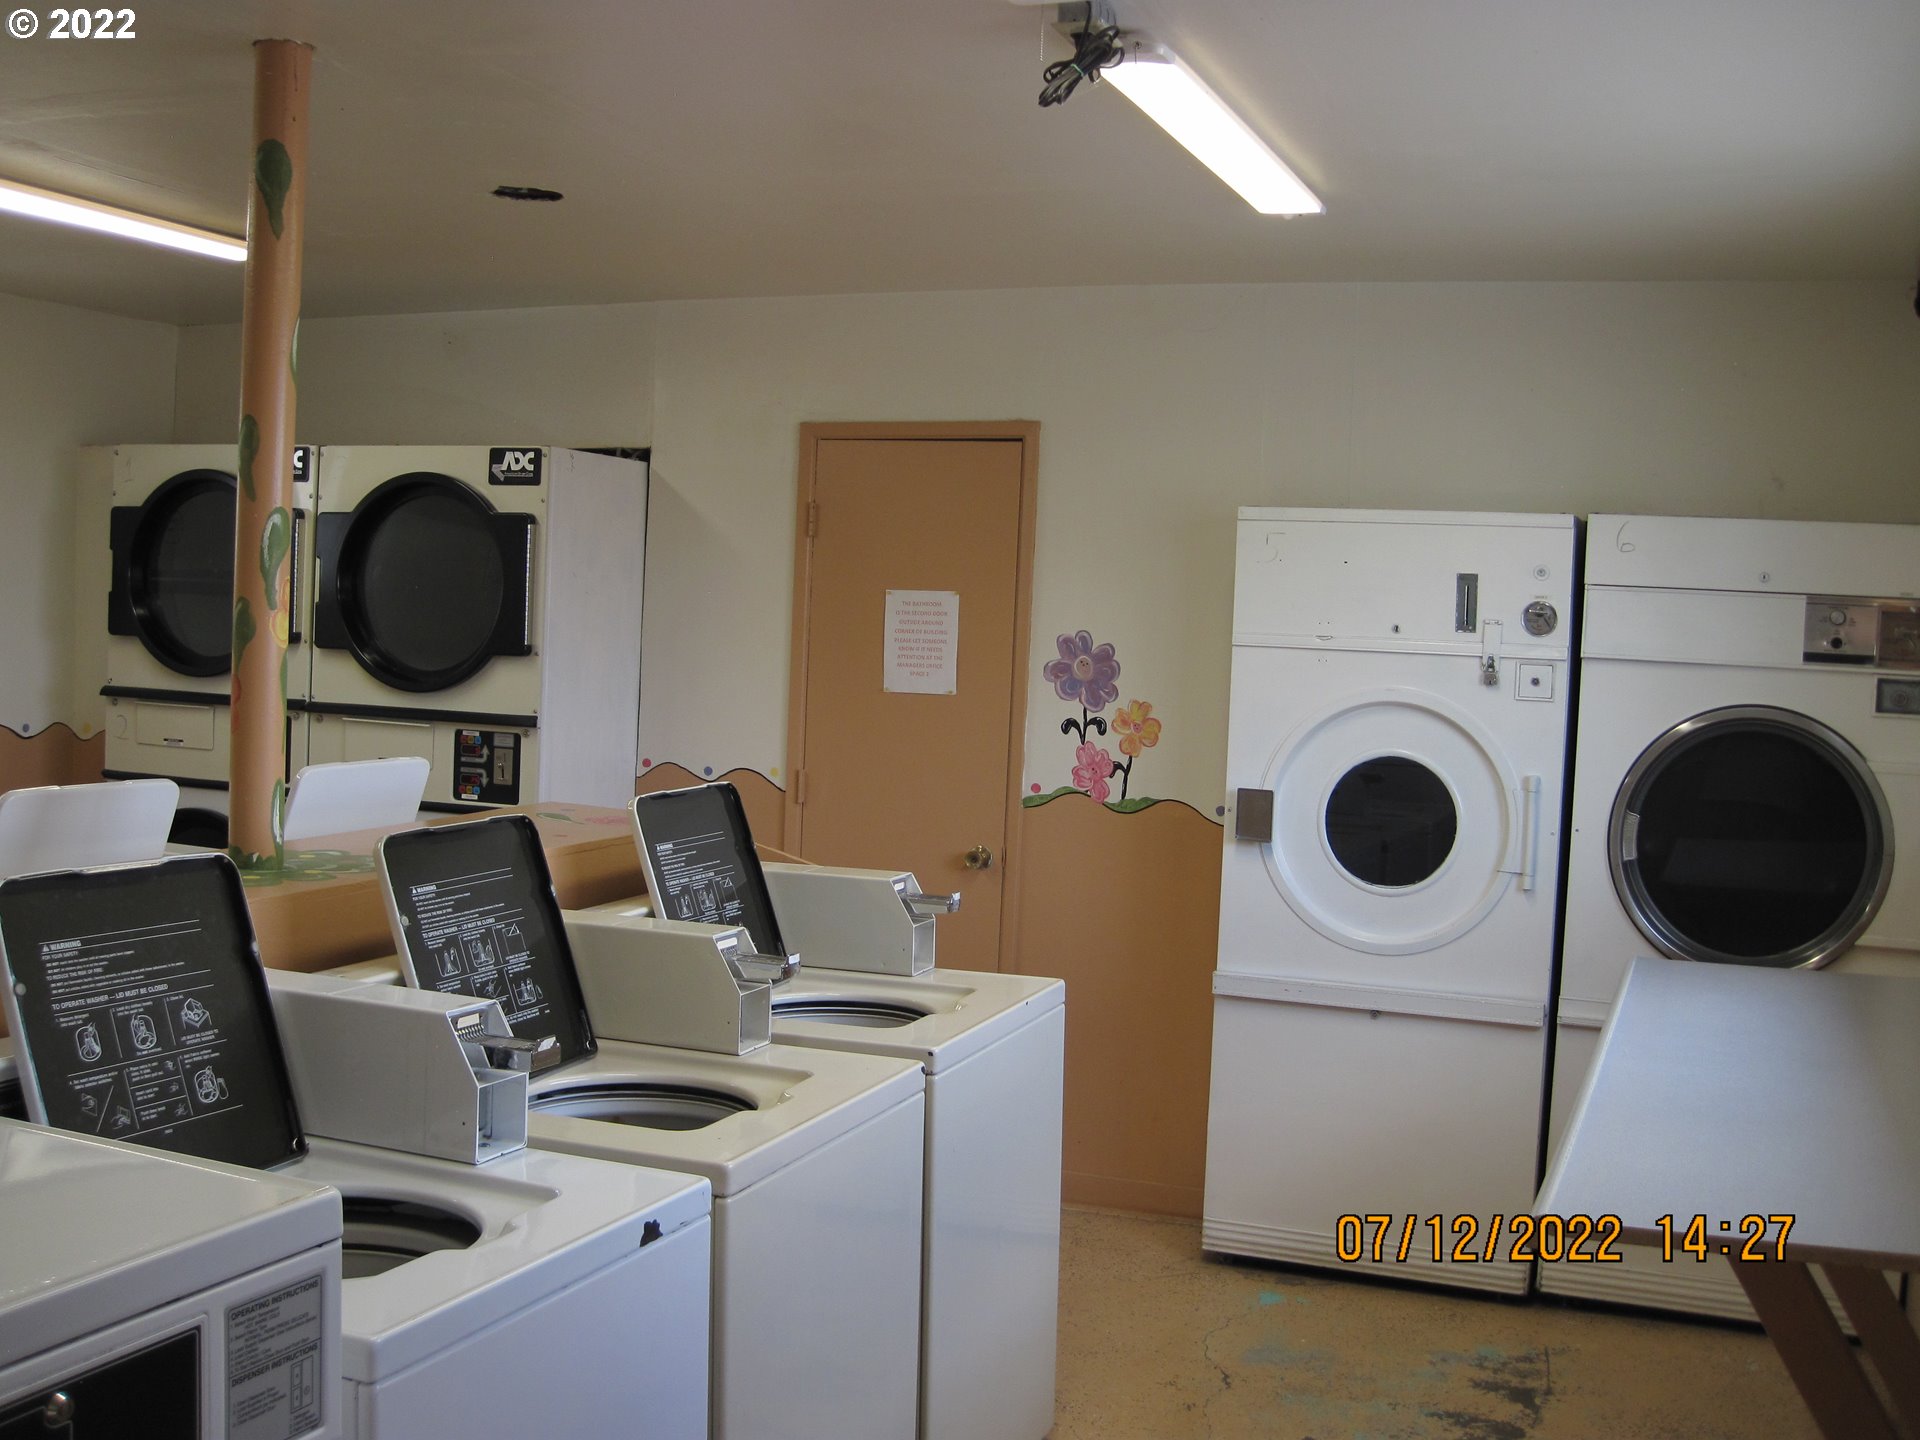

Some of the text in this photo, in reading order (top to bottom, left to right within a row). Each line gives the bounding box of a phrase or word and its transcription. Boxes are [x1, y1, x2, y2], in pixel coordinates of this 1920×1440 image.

[500, 451, 535, 471] ADC
[1616, 520, 1636, 553] 6
[112, 714, 129, 740] 2
[50, 940, 82, 951] WARNING
[61, 998, 86, 1009] OPERATE
[86, 994, 109, 1004] WASHER
[148, 984, 168, 993] CLOSED
[231, 1280, 319, 1321] OPERATING INSTRUCTIONS
[232, 1342, 318, 1388] DISPENSER INSTRUCTIONS
